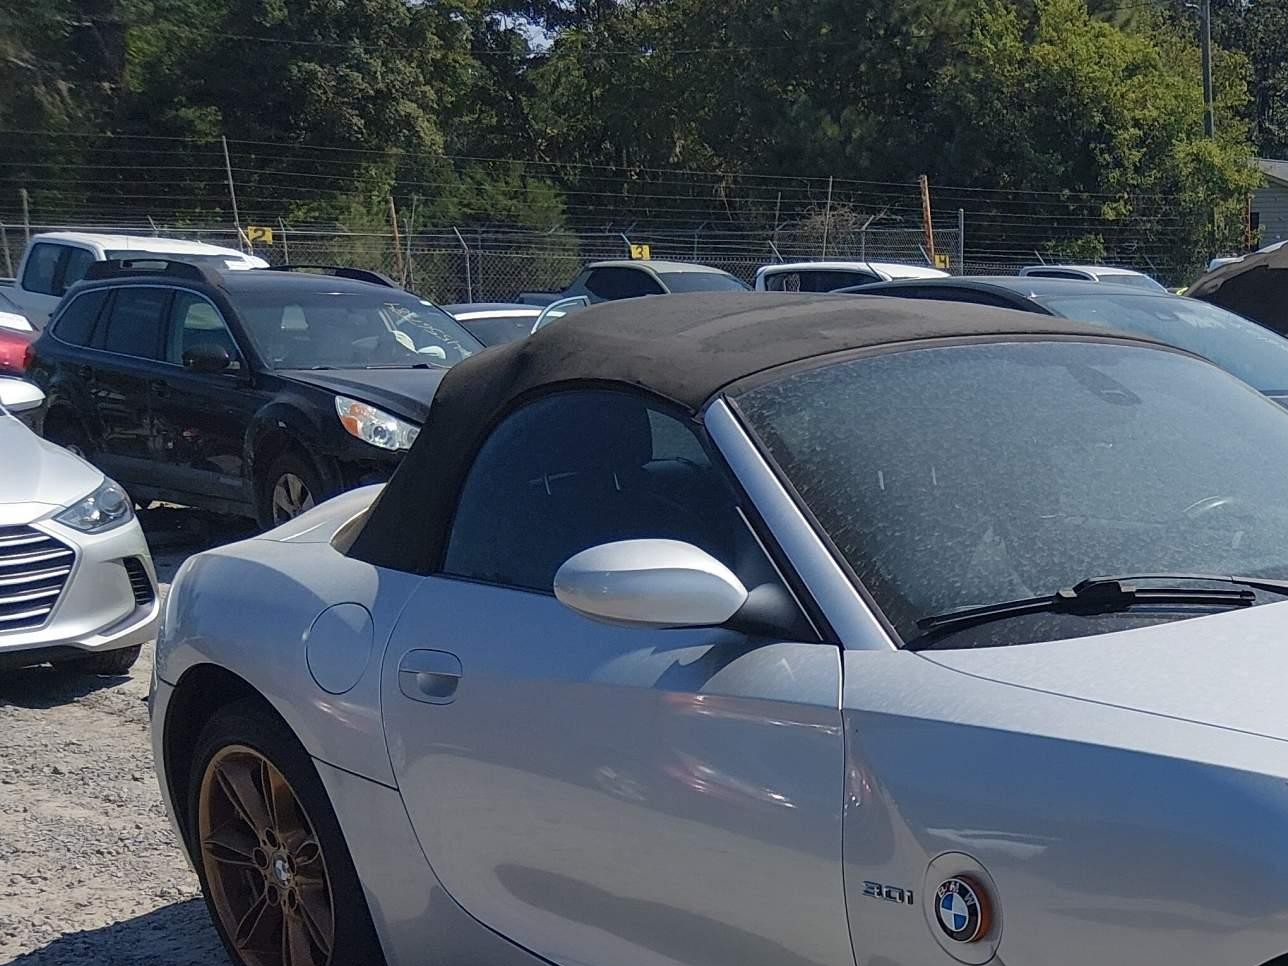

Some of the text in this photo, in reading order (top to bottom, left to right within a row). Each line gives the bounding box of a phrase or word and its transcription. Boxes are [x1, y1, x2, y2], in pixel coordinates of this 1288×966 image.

[252, 228, 267, 243] 2
[635, 246, 644, 260] 3
[938, 255, 947, 268] 4
[937, 881, 977, 906] BMW
